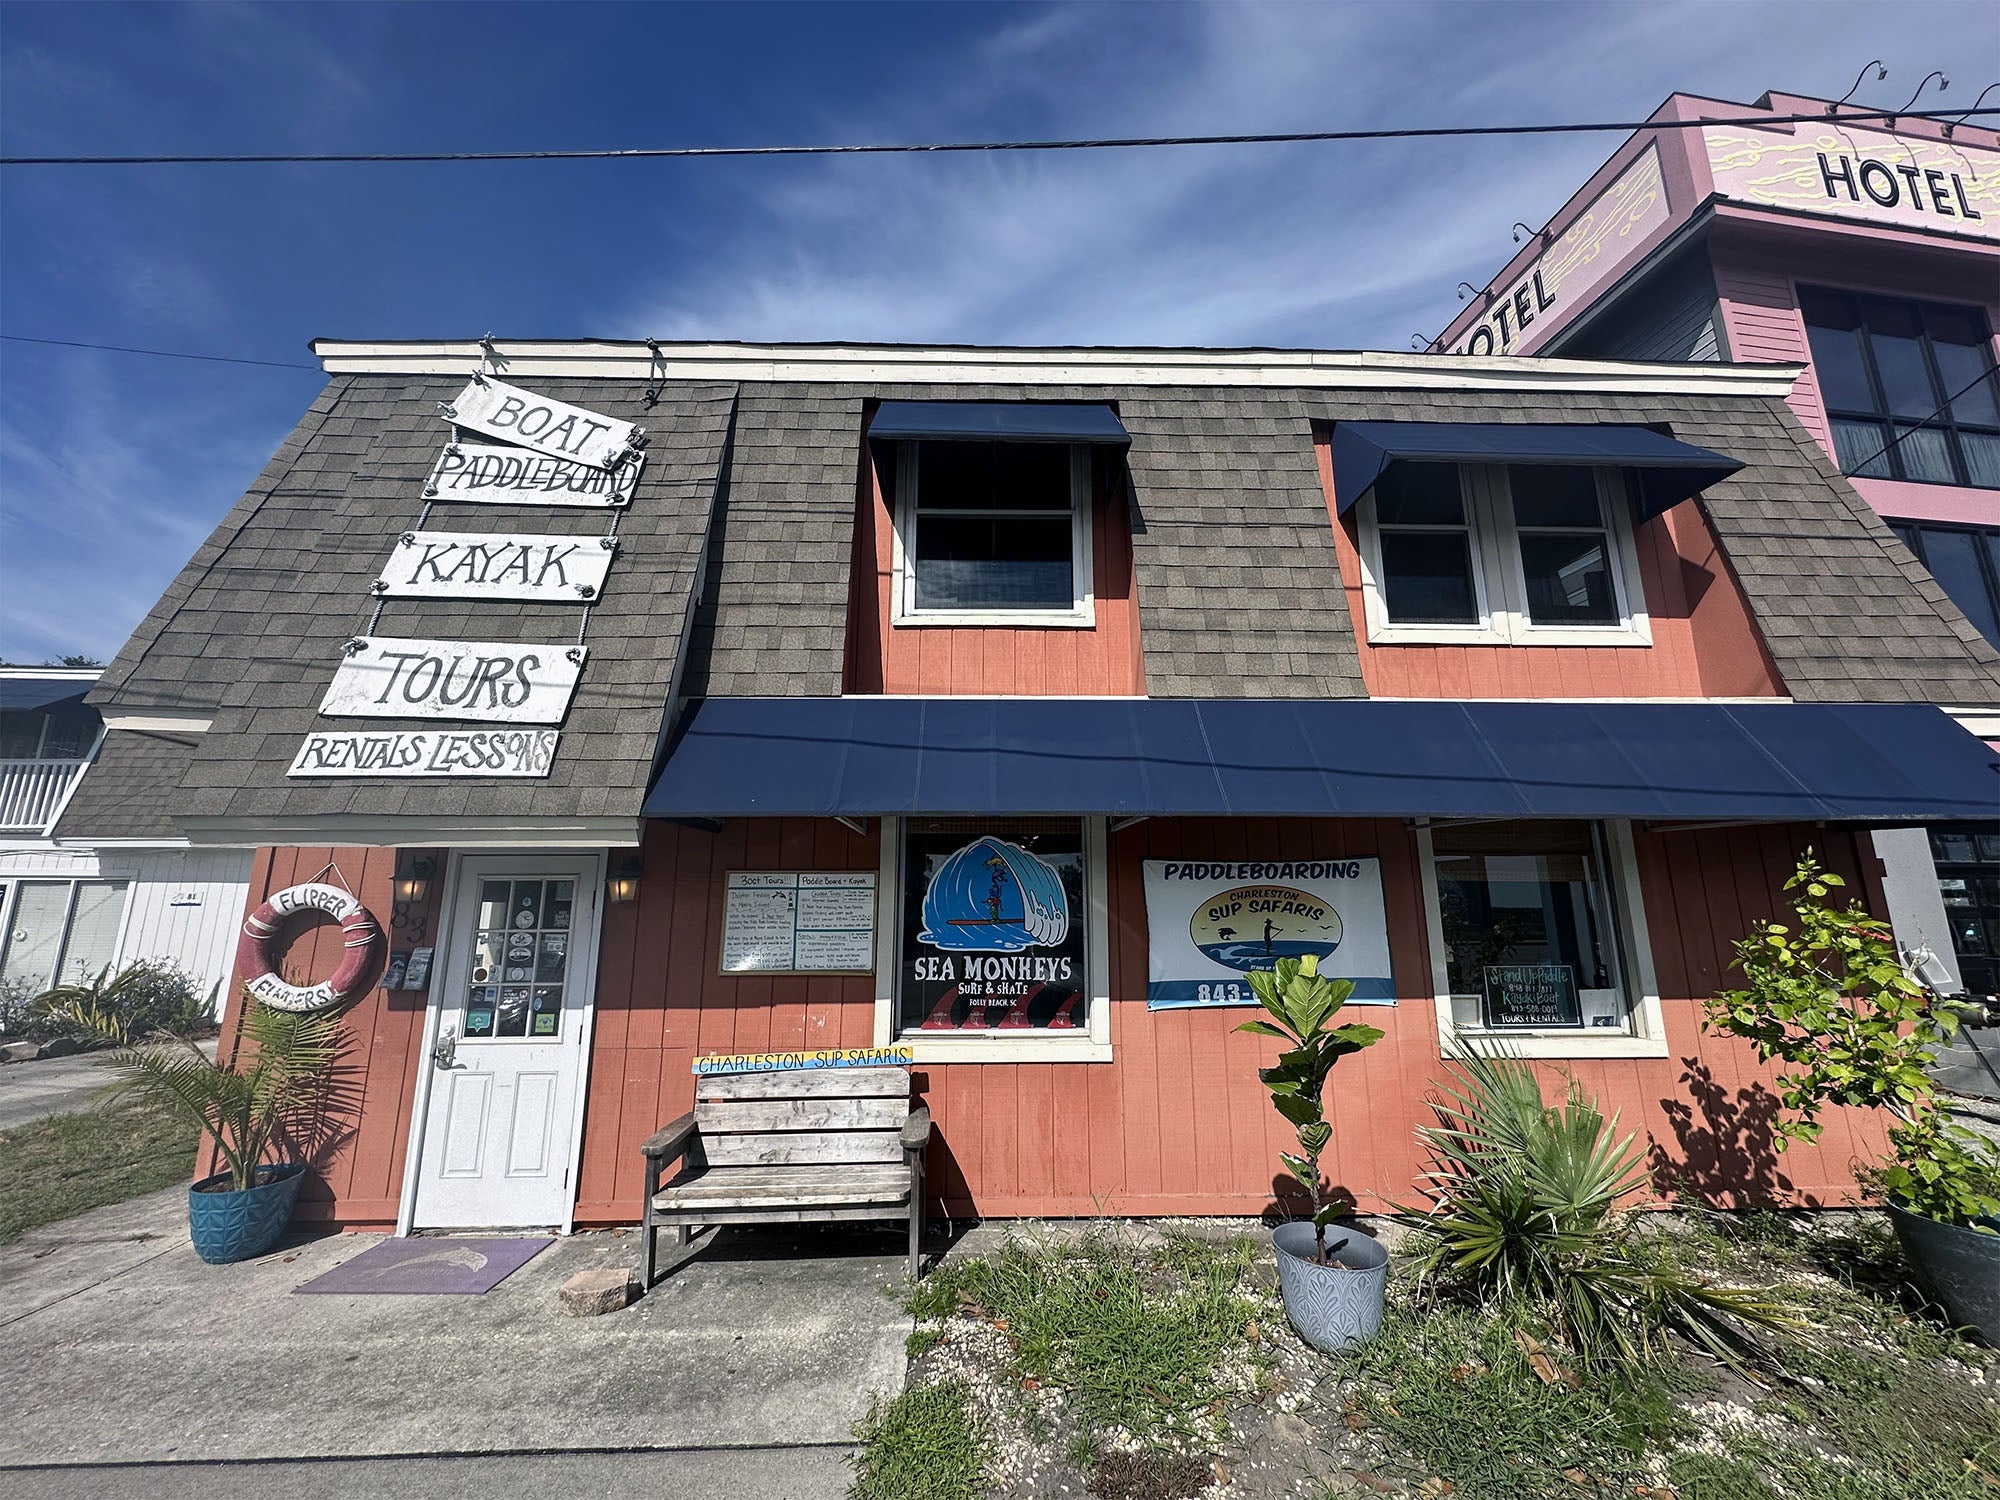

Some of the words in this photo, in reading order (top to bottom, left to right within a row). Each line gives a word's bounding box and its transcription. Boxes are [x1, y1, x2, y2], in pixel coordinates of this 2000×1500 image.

[1816, 152, 1982, 220] HOTEL
[1456, 269, 1556, 356] OTEL
[487, 395, 610, 456] BOAT
[438, 453, 638, 495] PADDLEBOARD
[406, 541, 581, 588] KAYAK
[373, 650, 541, 711] TOURS
[296, 734, 426, 770] RENTALS
[424, 732, 556, 772] LESSONS
[1163, 860, 1361, 881] PADDLEBOARDING
[278, 888, 349, 919] FLIPPER
[1229, 888, 1301, 903] CHARLESTON
[391, 901, 426, 943] 83
[1207, 900, 1243, 922] SUP
[1247, 898, 1325, 921] SAFARIS
[914, 956, 955, 982] SEA
[963, 955, 1072, 982] MONKEYS
[1490, 967, 1523, 985] Stand
[985, 981, 995, 995] &
[1502, 990, 1533, 1006] Kayak
[1536, 991, 1560, 1005] Boat
[969, 998, 987, 1007] FOLLY
[1009, 998, 1018, 1007] SC
[1499, 1012, 1526, 1024] TOURS
[1529, 1013, 1567, 1023] RENTALS
[698, 1052, 805, 1074] CHARLESTON
[813, 1050, 844, 1069] SUP
[847, 1046, 910, 1067] SAFARIS
